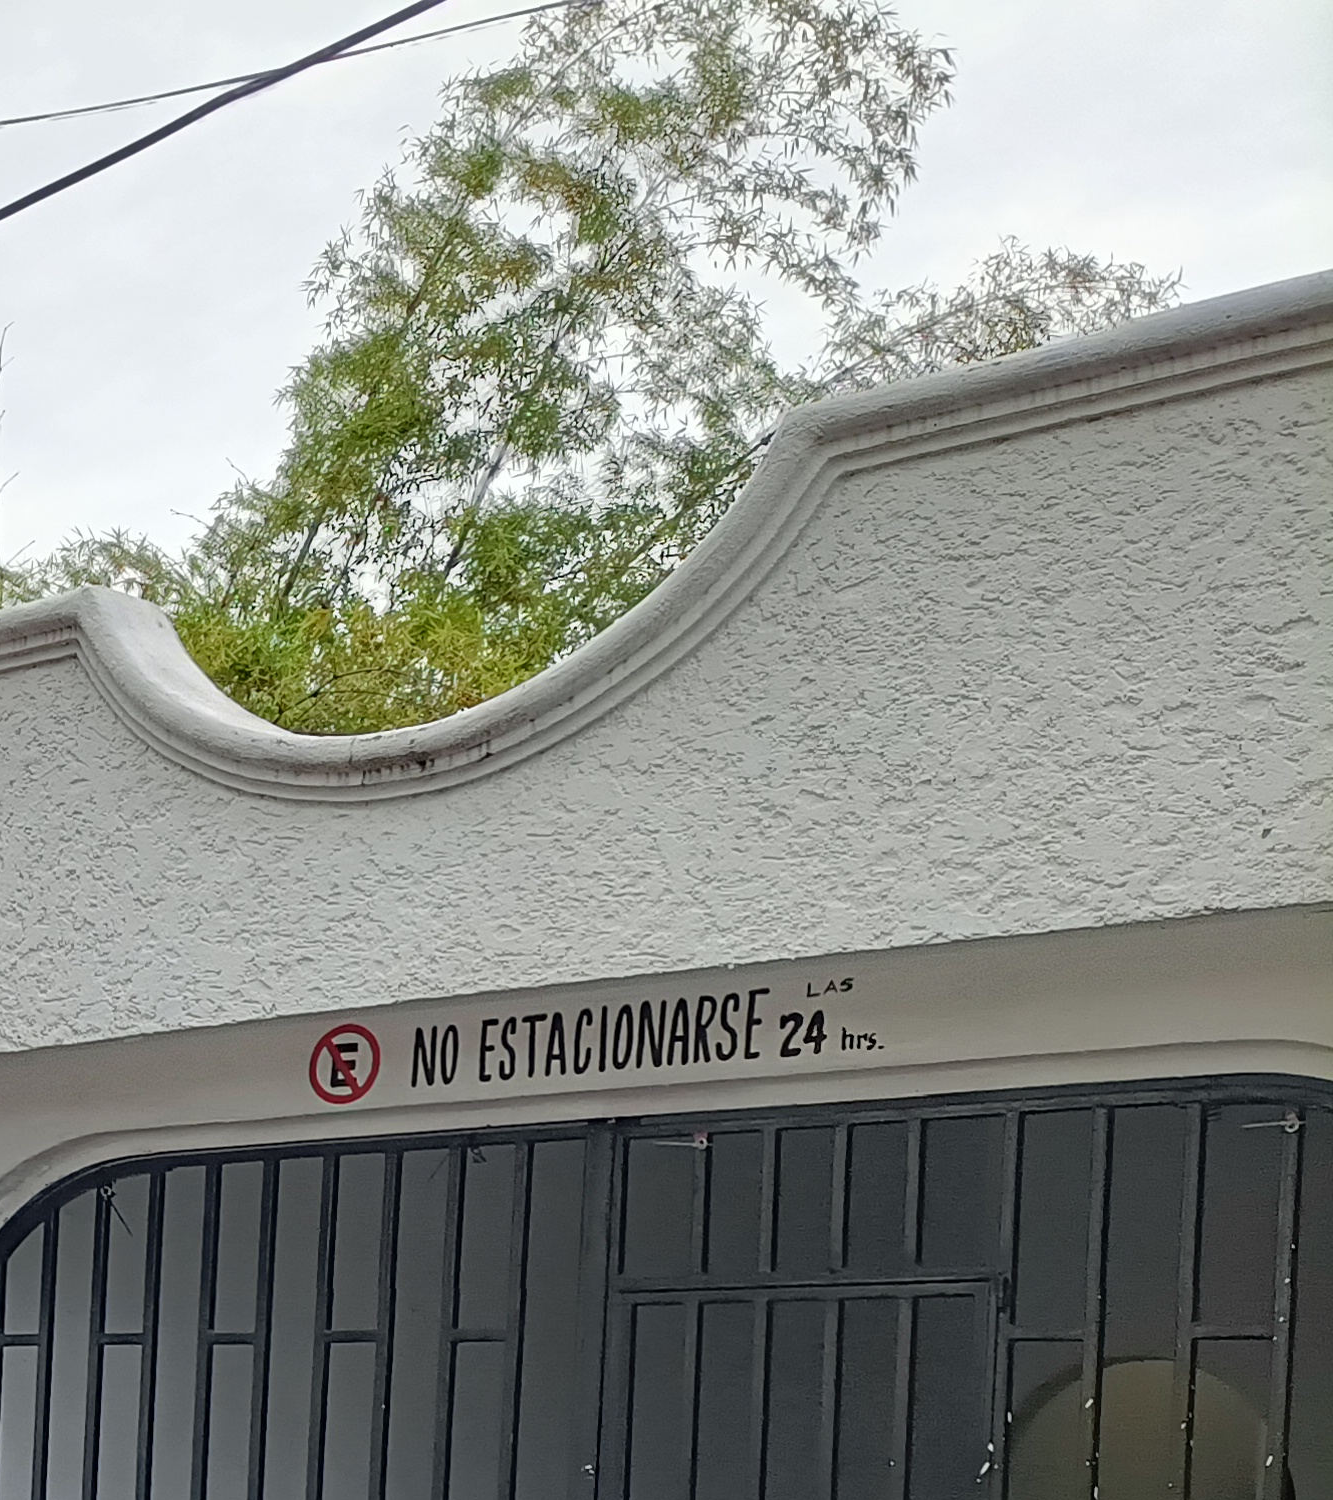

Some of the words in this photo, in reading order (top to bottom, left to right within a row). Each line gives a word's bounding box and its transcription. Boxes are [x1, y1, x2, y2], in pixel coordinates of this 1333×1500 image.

[805, 977, 855, 999] LAS
[410, 1024, 460, 1088] NO
[478, 988, 771, 1083] ESTACIONARSE
[778, 1009, 828, 1058] 24
[840, 1026, 885, 1053] hrs.
